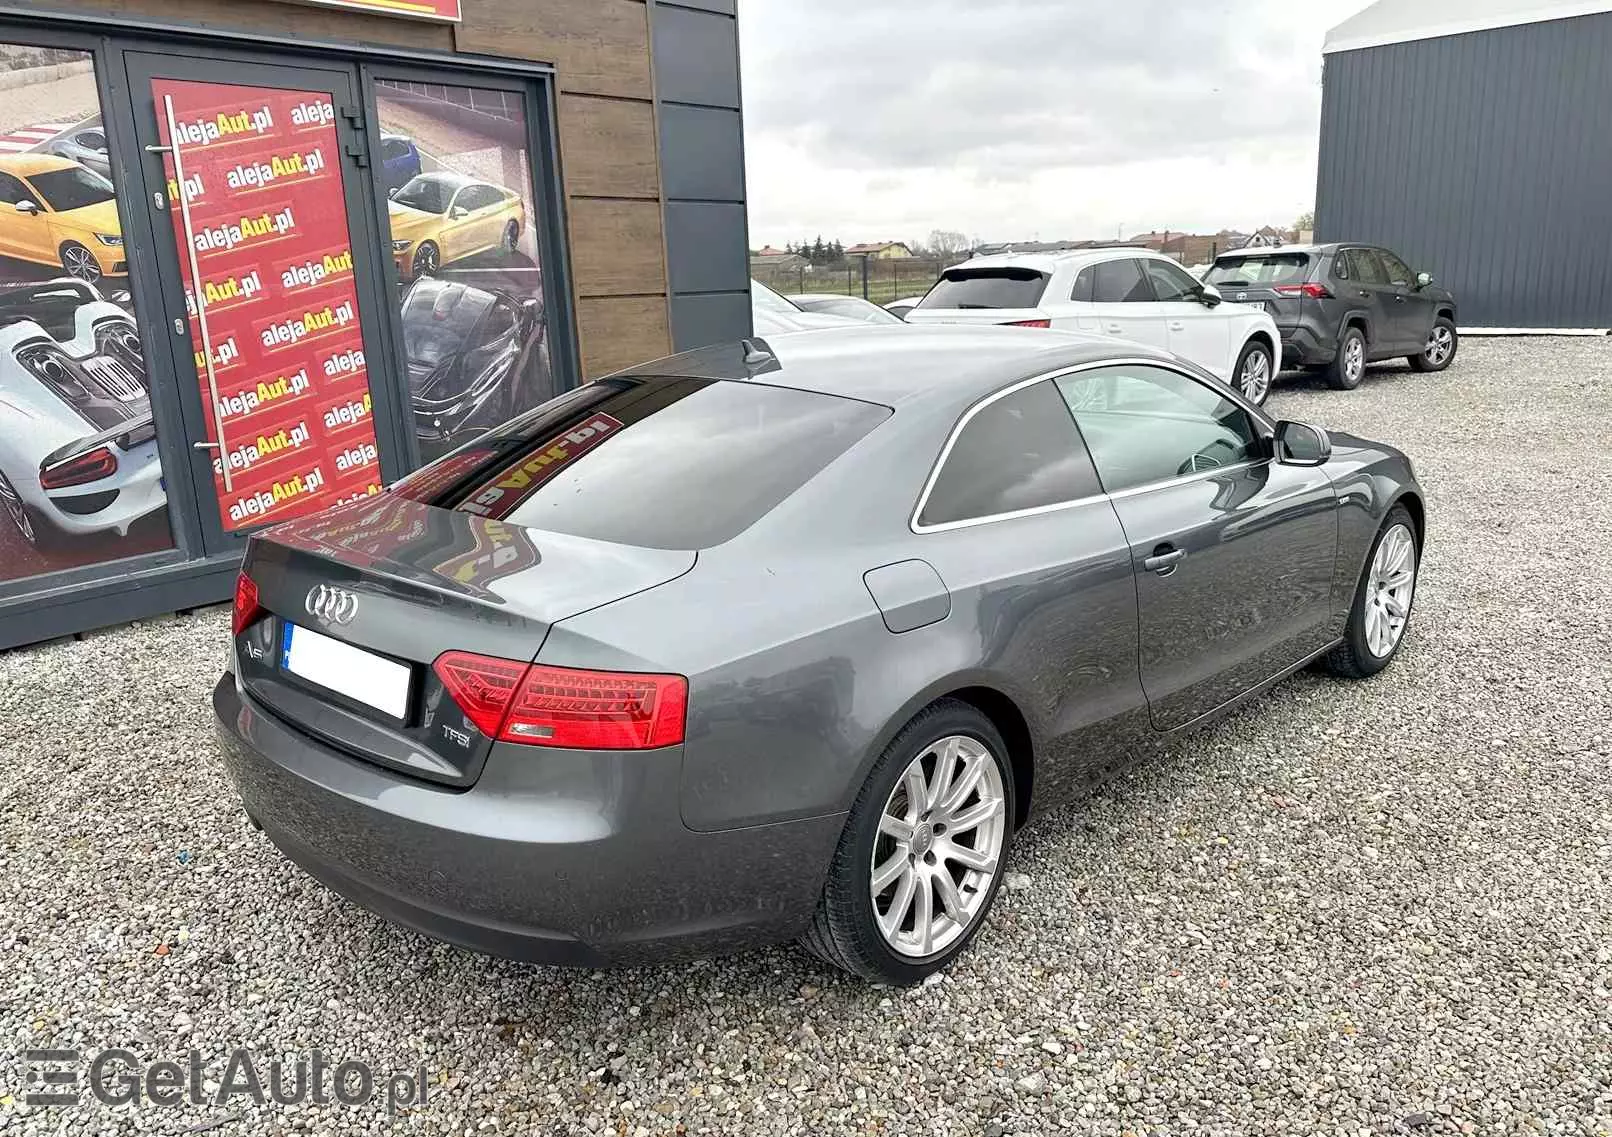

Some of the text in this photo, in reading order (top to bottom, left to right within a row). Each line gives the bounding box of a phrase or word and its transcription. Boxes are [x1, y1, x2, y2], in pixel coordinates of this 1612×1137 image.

[291, 100, 335, 125] aleja
[227, 148, 324, 187] alejaAut.pl
[194, 207, 295, 250] alejaAut.pl
[281, 251, 353, 288] alejaAut
[260, 301, 354, 347] alejaAut.pl
[323, 350, 366, 376] aleja
[229, 467, 325, 521] alejaAut.pl
[442, 724, 470, 748] TFSI
